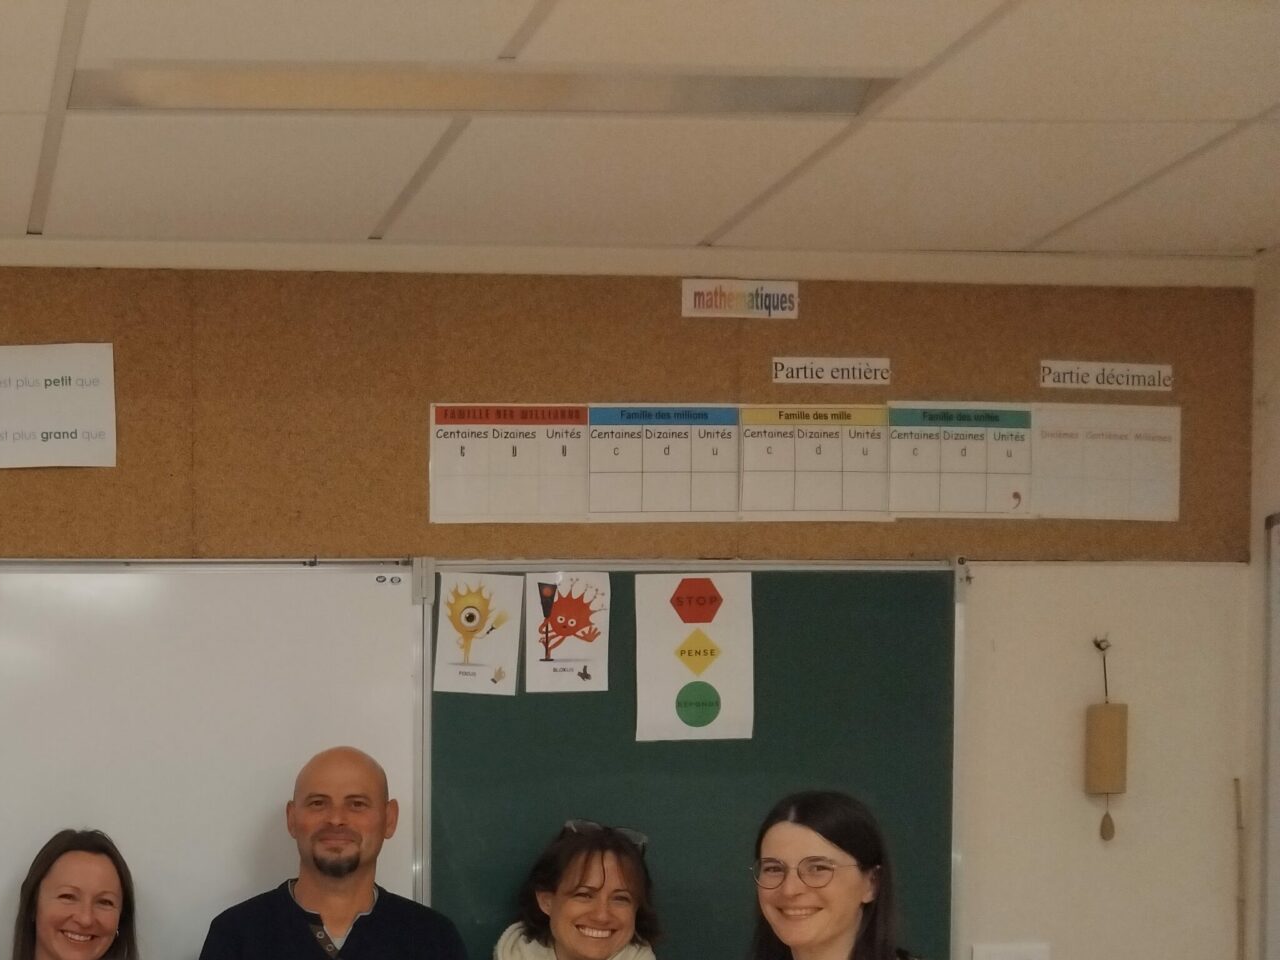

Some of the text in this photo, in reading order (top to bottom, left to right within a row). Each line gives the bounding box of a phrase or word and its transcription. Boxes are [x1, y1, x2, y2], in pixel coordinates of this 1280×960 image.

[773, 361, 890, 380] Partie entière
[1042, 366, 1172, 387] Partie décimale
[16, 376, 40, 390] plus
[44, 376, 72, 390] petit
[75, 376, 100, 390] que
[778, 411, 852, 421] Famille des mille
[12, 430, 37, 443] plus
[40, 429, 78, 442] grand
[81, 430, 107, 442] que
[436, 428, 489, 439] Centaines
[492, 428, 536, 439] Dizaines
[546, 428, 581, 439] Unités
[591, 429, 641, 439] Centaines
[645, 429, 689, 439] Dizaines
[698, 429, 732, 439] Unités
[744, 429, 794, 439] Centaines
[797, 429, 840, 439] Dizaines
[849, 430, 881, 439] Unités
[890, 430, 940, 440] Centaines
[943, 430, 985, 441] Dizaines
[993, 431, 1025, 441] Unités
[663, 445, 670, 456] d
[677, 596, 717, 607] STOP
[680, 649, 716, 657] PENSE
